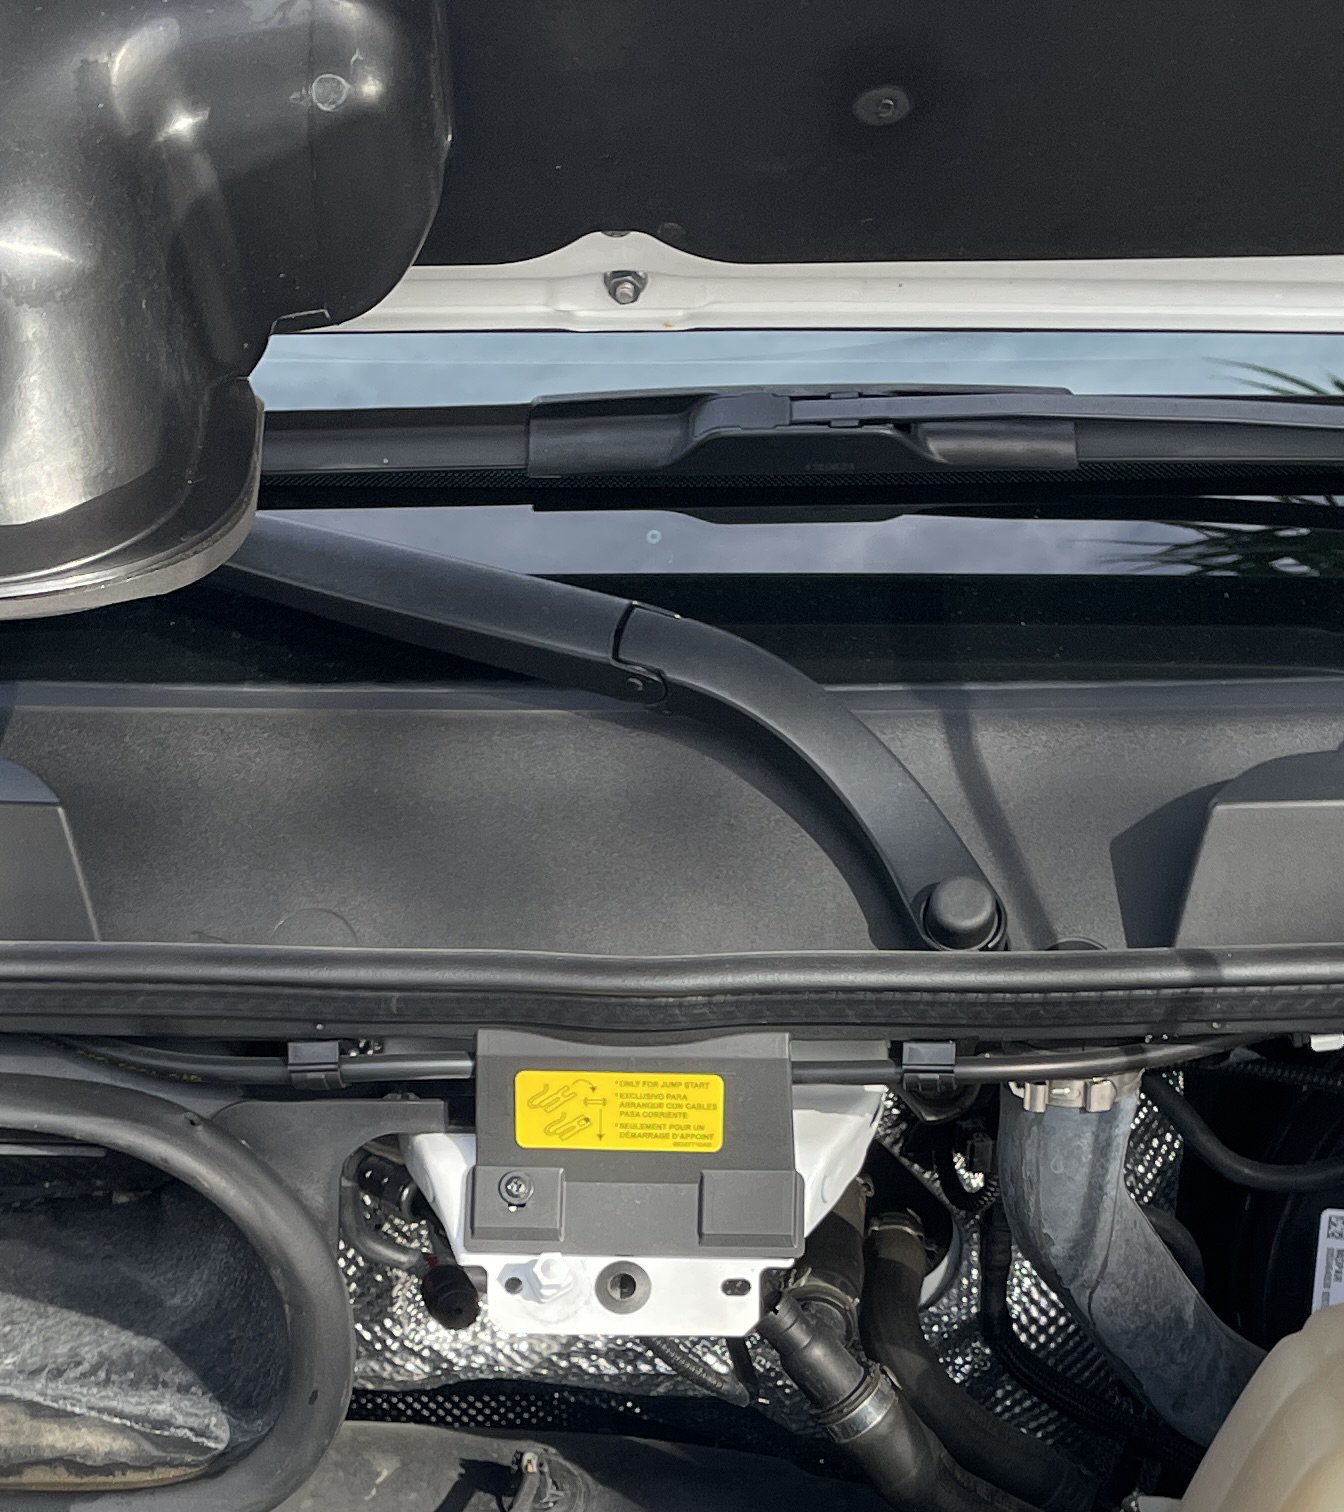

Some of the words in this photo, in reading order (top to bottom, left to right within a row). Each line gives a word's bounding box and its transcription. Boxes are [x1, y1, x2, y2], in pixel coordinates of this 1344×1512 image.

[619, 1080, 640, 1088] ONLY
[661, 1081, 683, 1089] JUMP
[684, 1081, 711, 1089] START
[666, 1093, 688, 1101] PARA
[685, 1103, 718, 1111] CABLES
